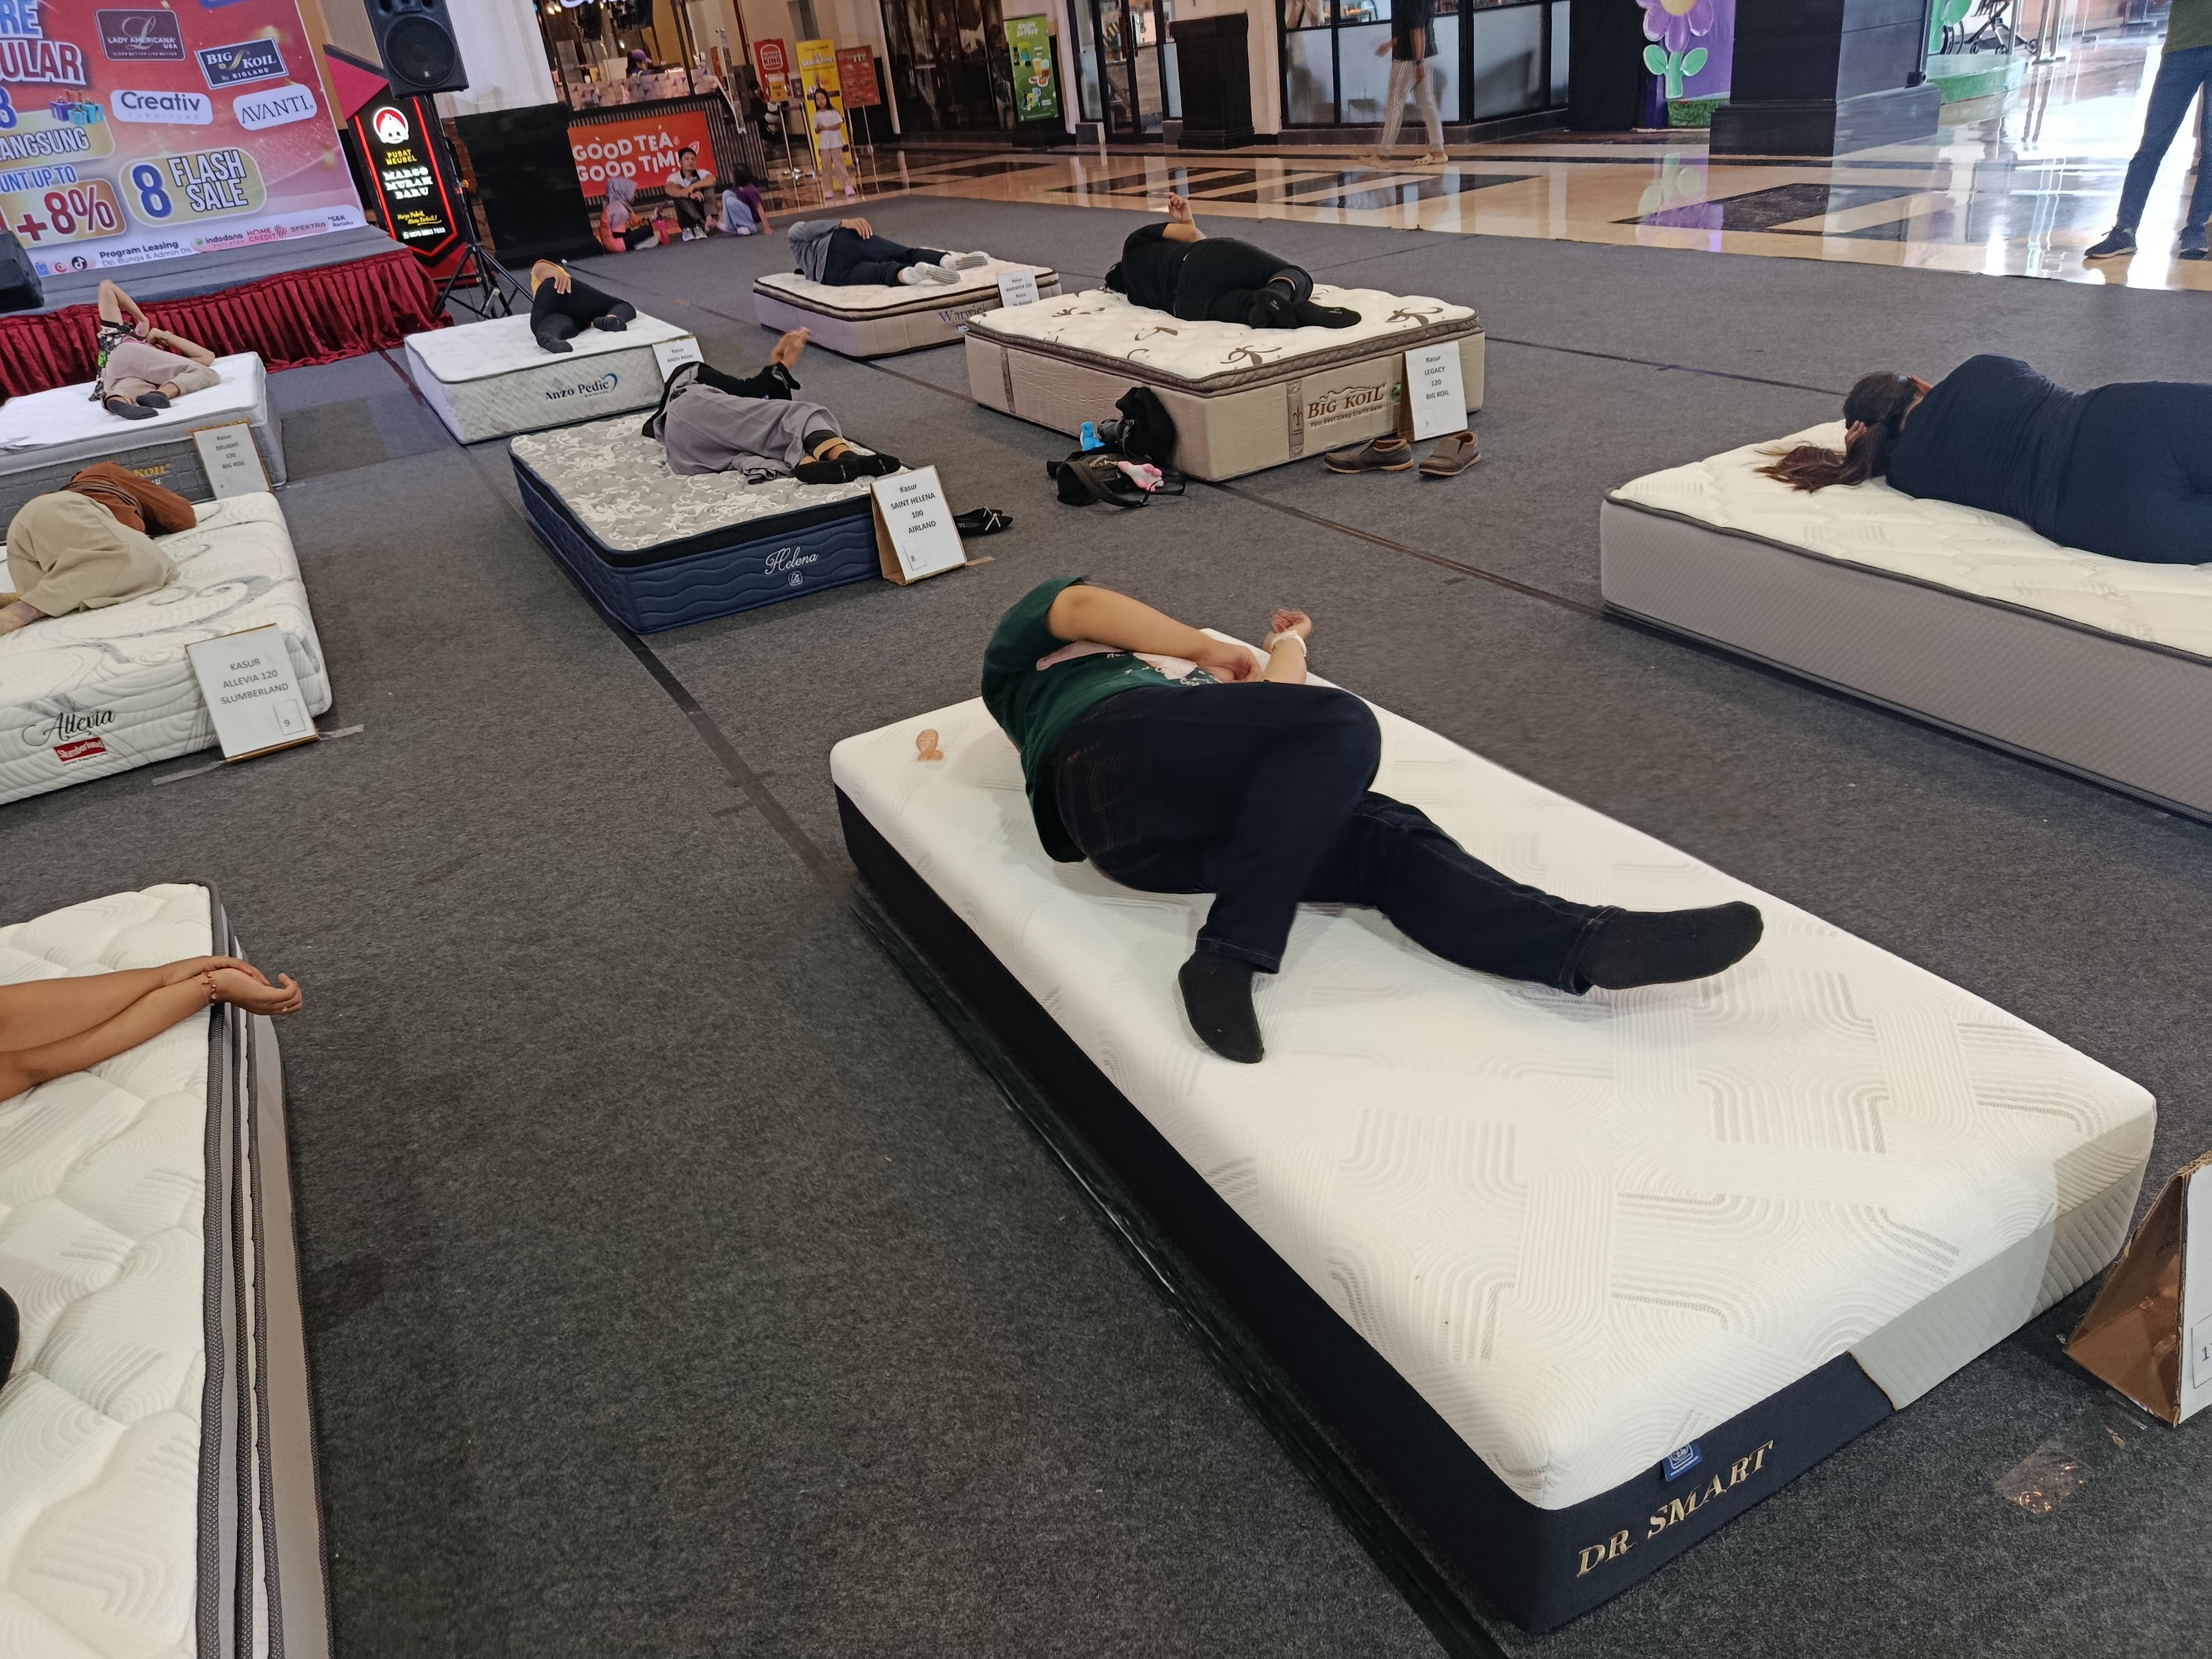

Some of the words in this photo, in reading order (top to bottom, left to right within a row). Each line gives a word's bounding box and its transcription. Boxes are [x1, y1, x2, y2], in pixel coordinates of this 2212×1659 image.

[206, 52, 232, 65] BIG
[242, 55, 276, 69] KOIL
[764, 56, 781, 66] KING
[121, 91, 200, 111] Creativ
[242, 95, 309, 124] AVANTI
[0, 127, 90, 161] ANGSUNG
[572, 139, 633, 161] GOOD
[634, 132, 674, 152] TEA
[385, 155, 418, 165] MEUBEL
[387, 149, 411, 159] PUSAT
[168, 150, 247, 187] FLASH
[576, 160, 636, 182] GOOD
[0, 171, 29, 193] UNT
[32, 169, 53, 188] UP
[55, 165, 77, 184] TO
[132, 164, 173, 218] 8
[186, 178, 249, 212] SALE
[247, 227, 272, 236] HOME
[290, 222, 326, 232] SPEKTRA
[249, 233, 275, 242] CREDIT
[100, 247, 141, 259] Program
[143, 242, 179, 252] Leasing
[153, 250, 179, 258] Admin
[938, 304, 988, 324] Warwick
[1424, 366, 1445, 375] LEGACY
[545, 388, 575, 401] Anzo
[577, 380, 609, 394] Pedic
[1307, 400, 1337, 419] BIG
[1344, 386, 1385, 409] KOIL
[216, 442, 239, 451] DELIGHT
[899, 483, 918, 493] Kasur
[890, 498, 910, 510] SAINT
[910, 492, 936, 505] HELENA
[911, 509, 924, 519] 100
[907, 520, 937, 534] AIRLAND
[764, 546, 818, 575] Helena
[230, 658, 261, 671] KASUR
[223, 675, 259, 688] ALLEVIA
[261, 669, 278, 681] 120
[221, 683, 289, 705] SLUMBERLAND
[23, 710, 116, 747] Allevia
[284, 719, 290, 727] 9
[57, 740, 104, 758] Slumberland
[2201, 1343, 2212, 1361] 1
[1575, 1529, 1637, 1578] DR
[1647, 1439, 1774, 1540] SMART
